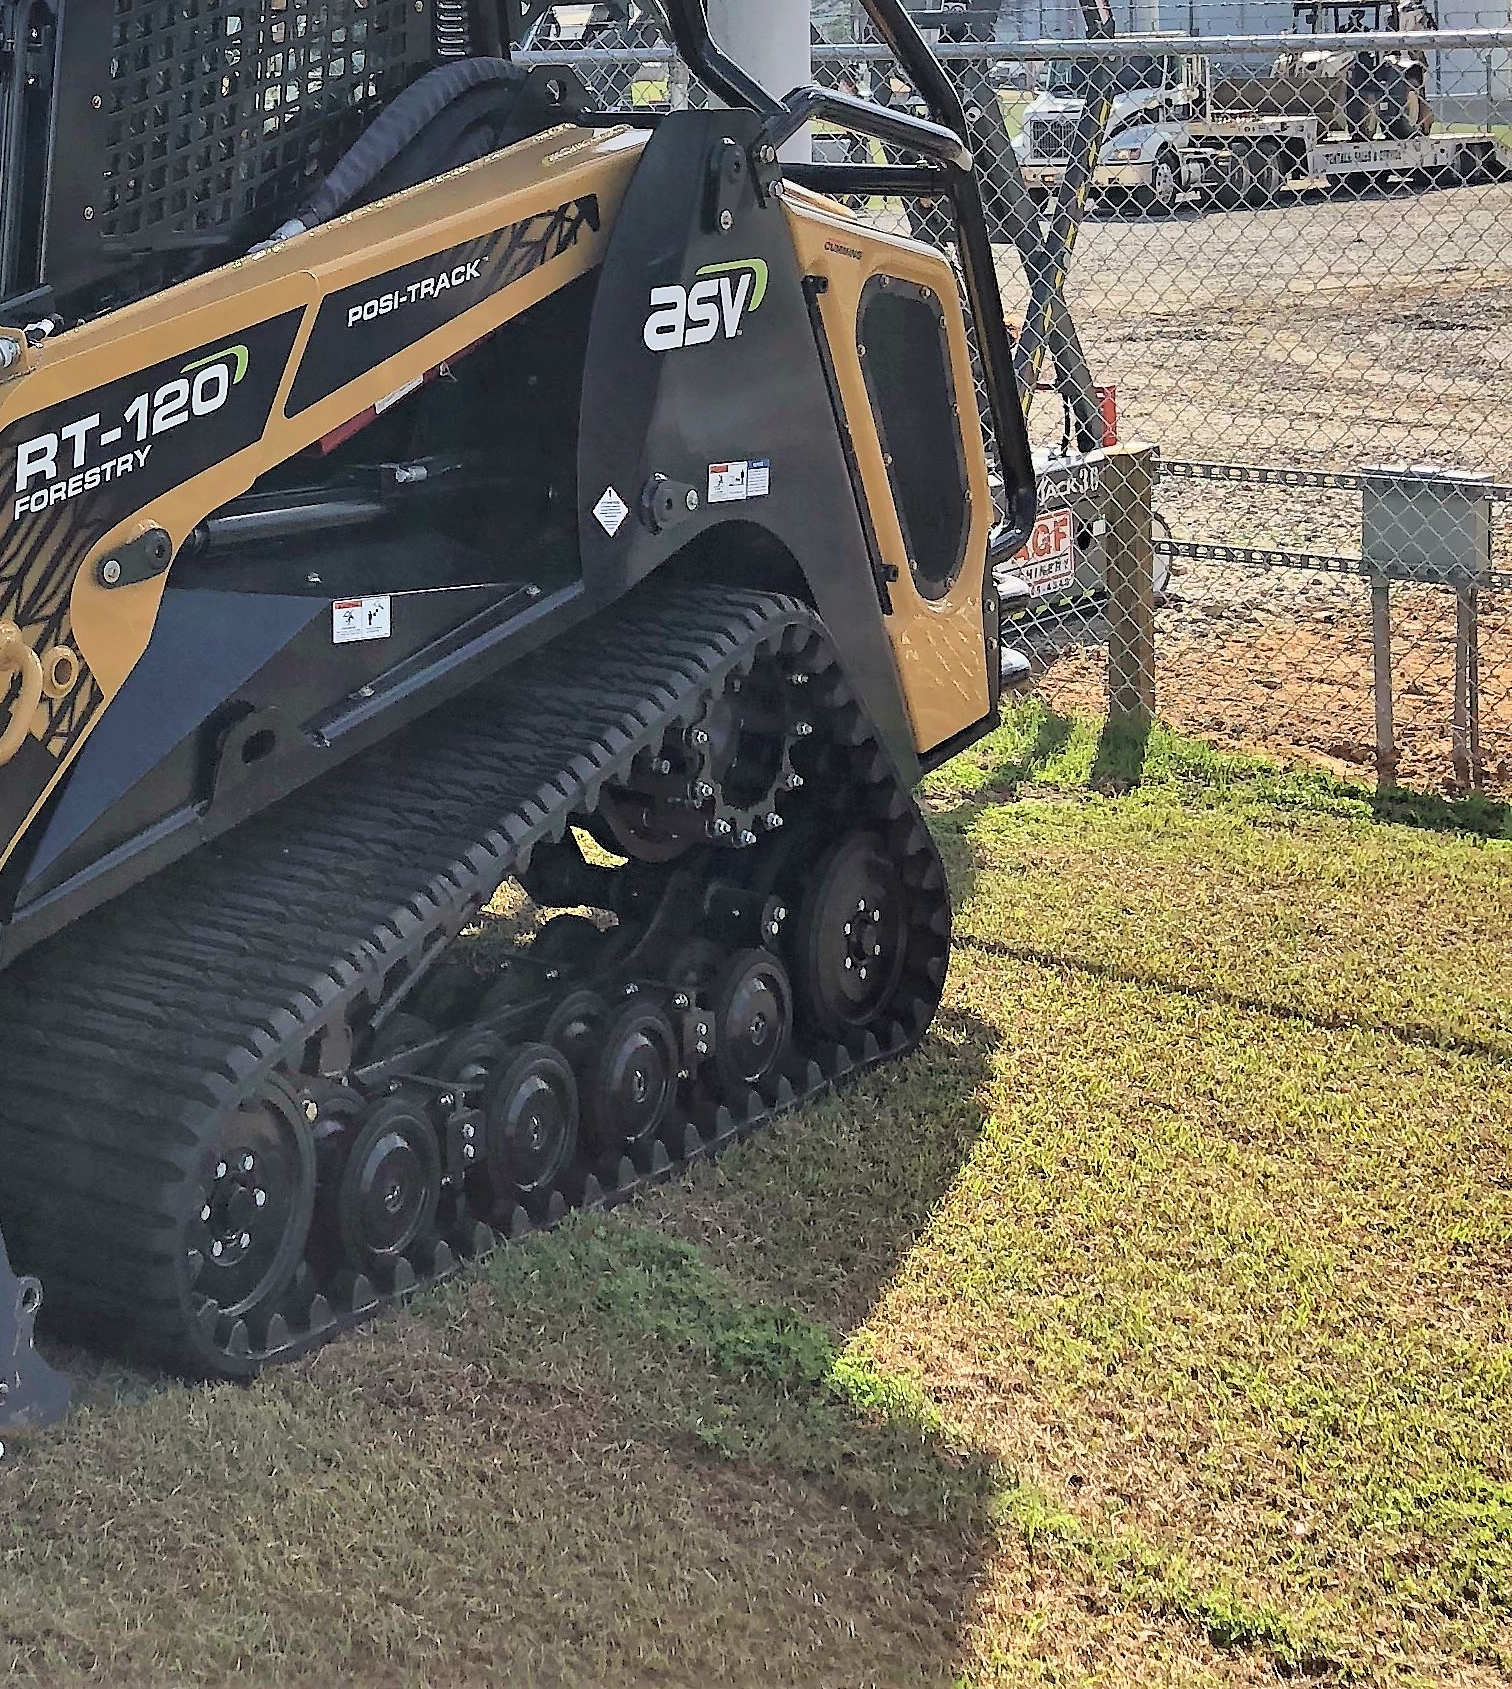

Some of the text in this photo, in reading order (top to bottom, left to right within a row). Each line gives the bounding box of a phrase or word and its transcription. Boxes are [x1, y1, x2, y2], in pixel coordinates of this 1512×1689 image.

[347, 258, 481, 328] POSI-TRACK
[14, 357, 232, 493] RT-120
[13, 444, 153, 521] FORESTRY
